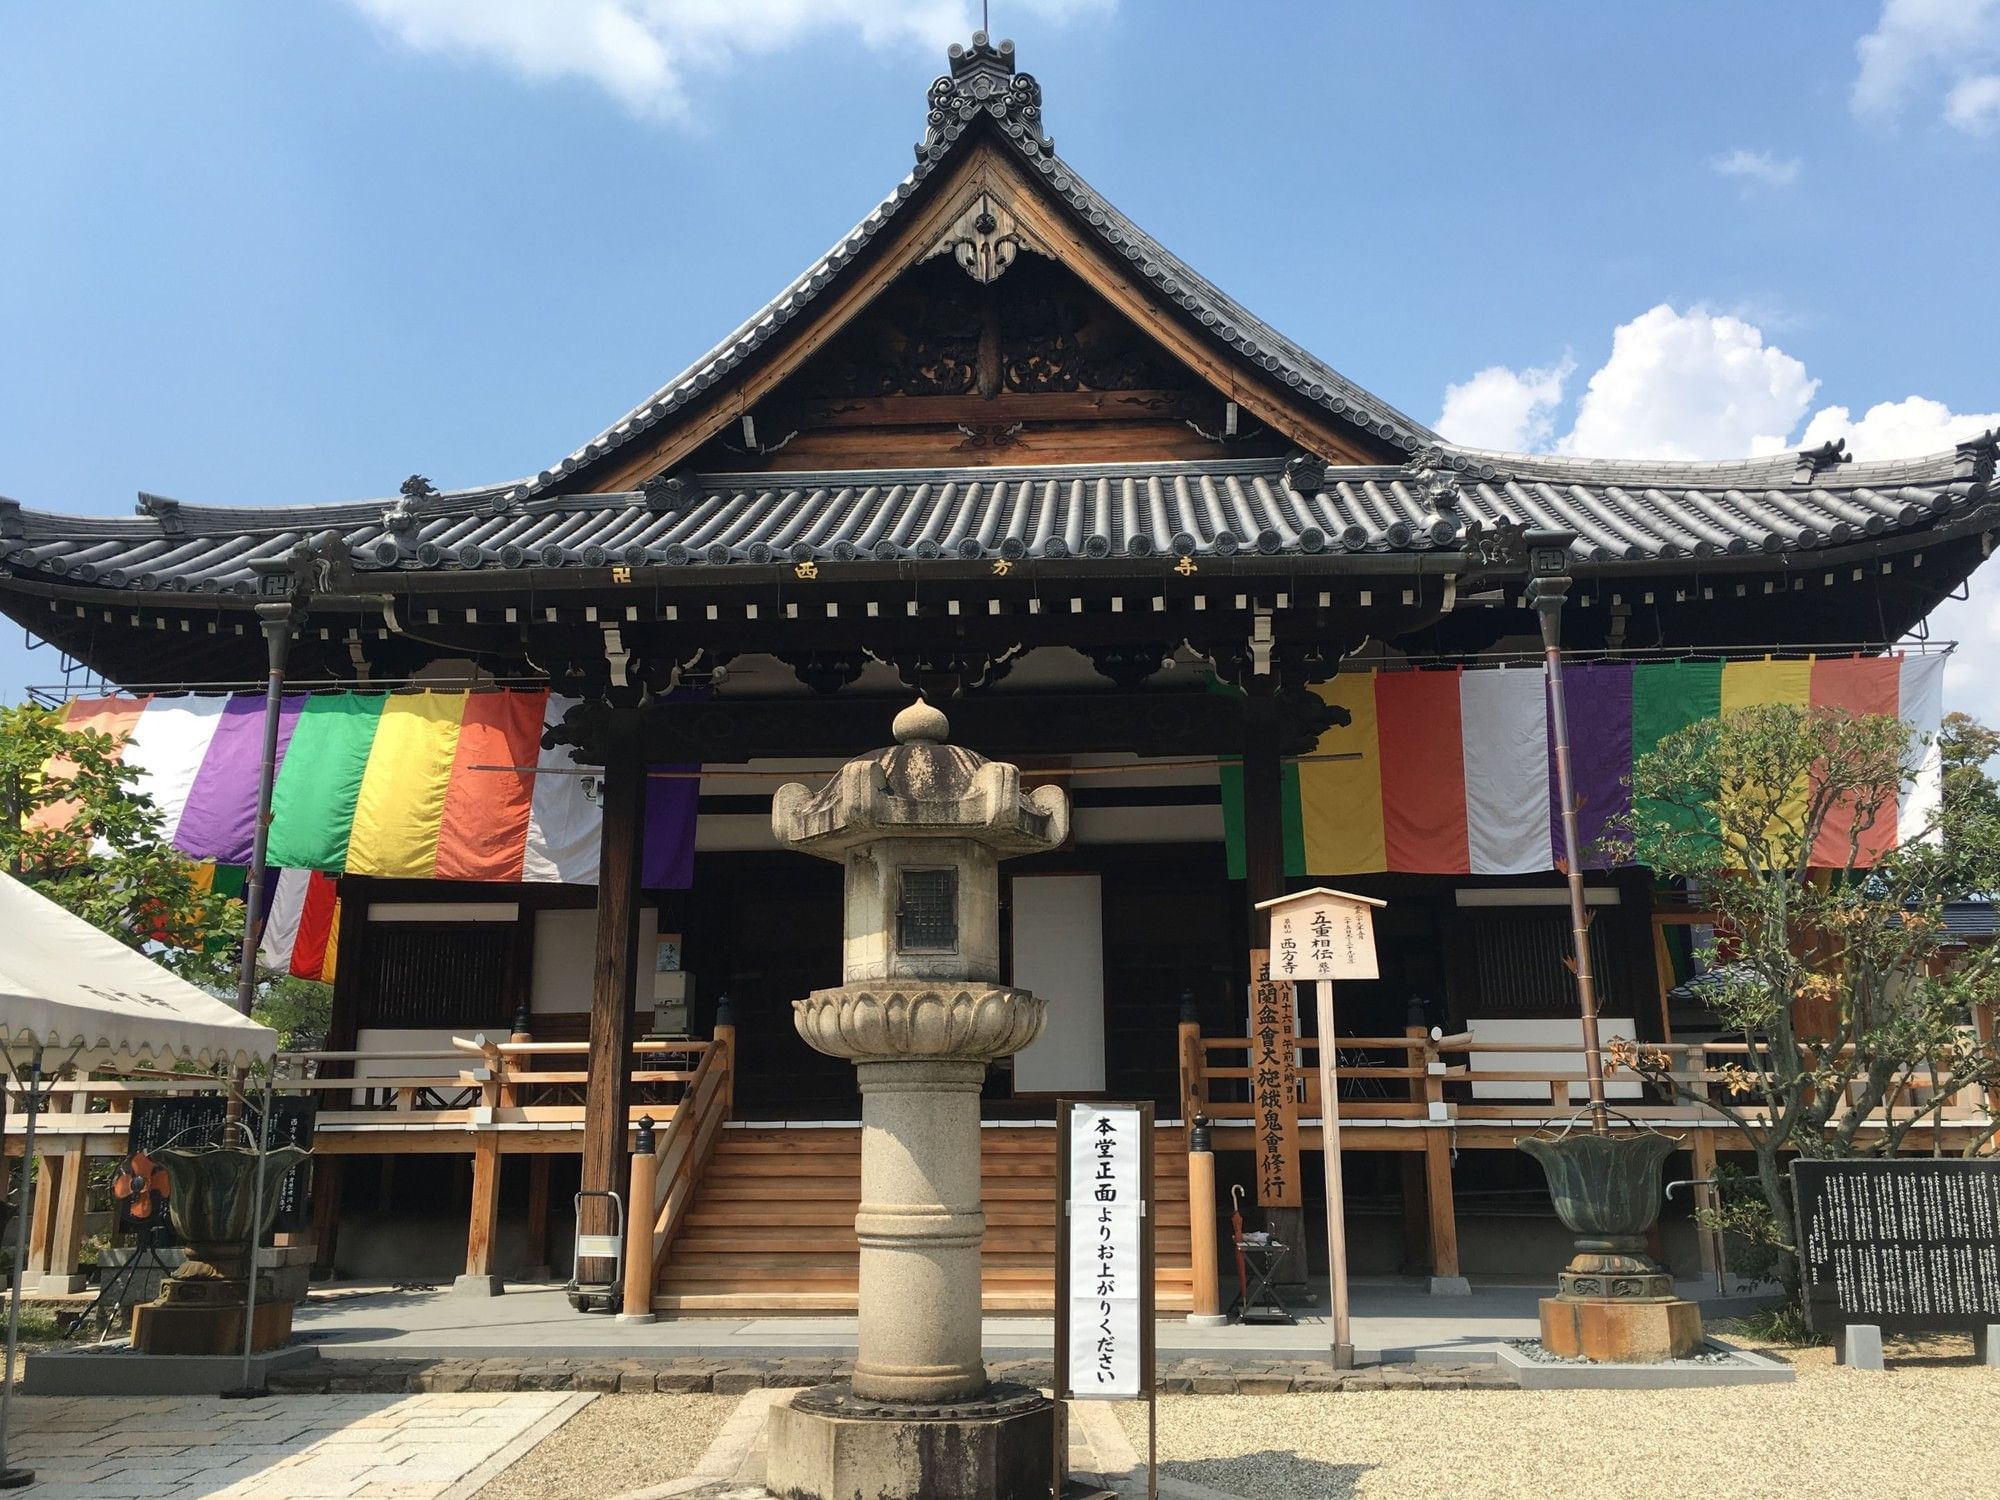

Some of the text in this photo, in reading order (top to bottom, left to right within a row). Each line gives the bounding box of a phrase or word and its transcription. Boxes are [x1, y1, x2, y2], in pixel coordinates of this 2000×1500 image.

[1280, 938, 1299, 974] 西方寺
[1094, 1117, 1118, 1384] 本堂正面よりお上がりください
